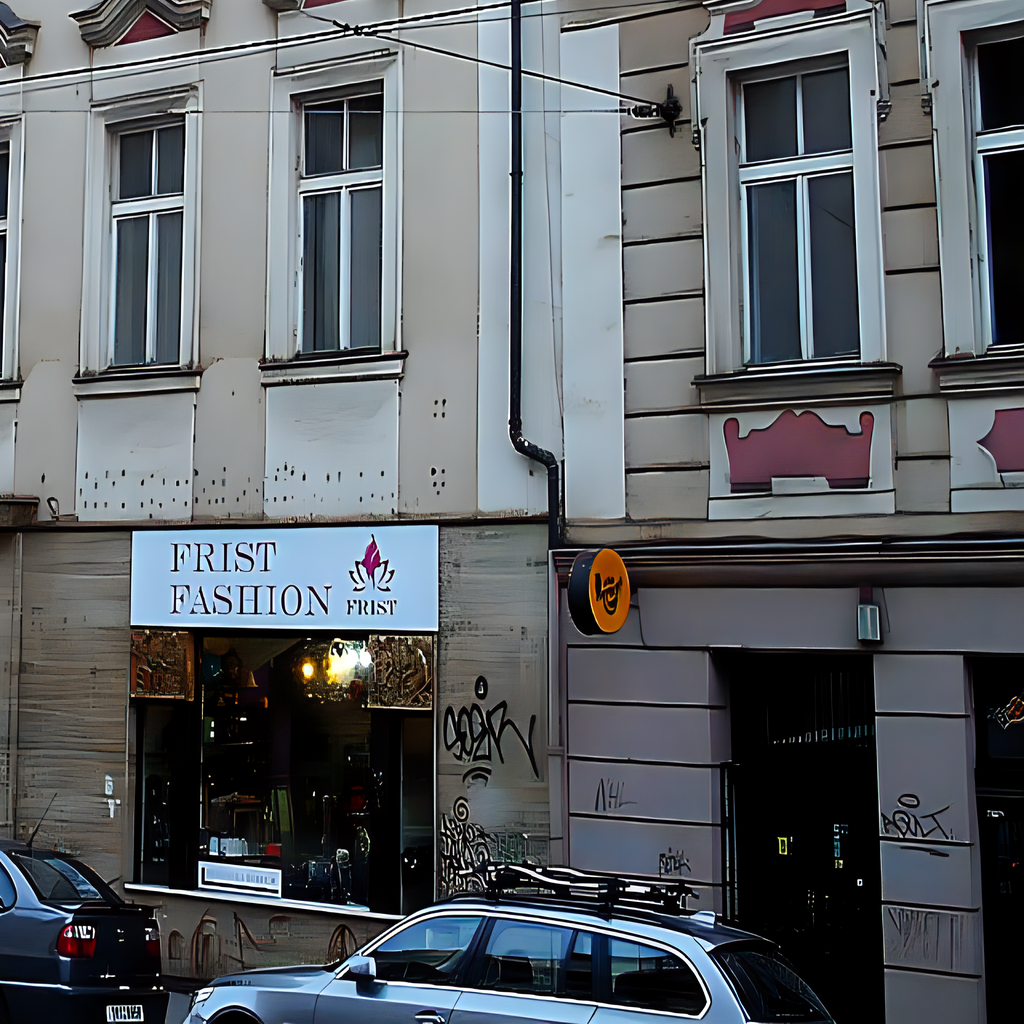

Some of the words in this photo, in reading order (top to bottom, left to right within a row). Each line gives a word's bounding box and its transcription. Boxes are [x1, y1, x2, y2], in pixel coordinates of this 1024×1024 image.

[170, 541, 277, 573] FRIST
[169, 584, 333, 616] FASHION
[346, 599, 398, 616] FRIST
